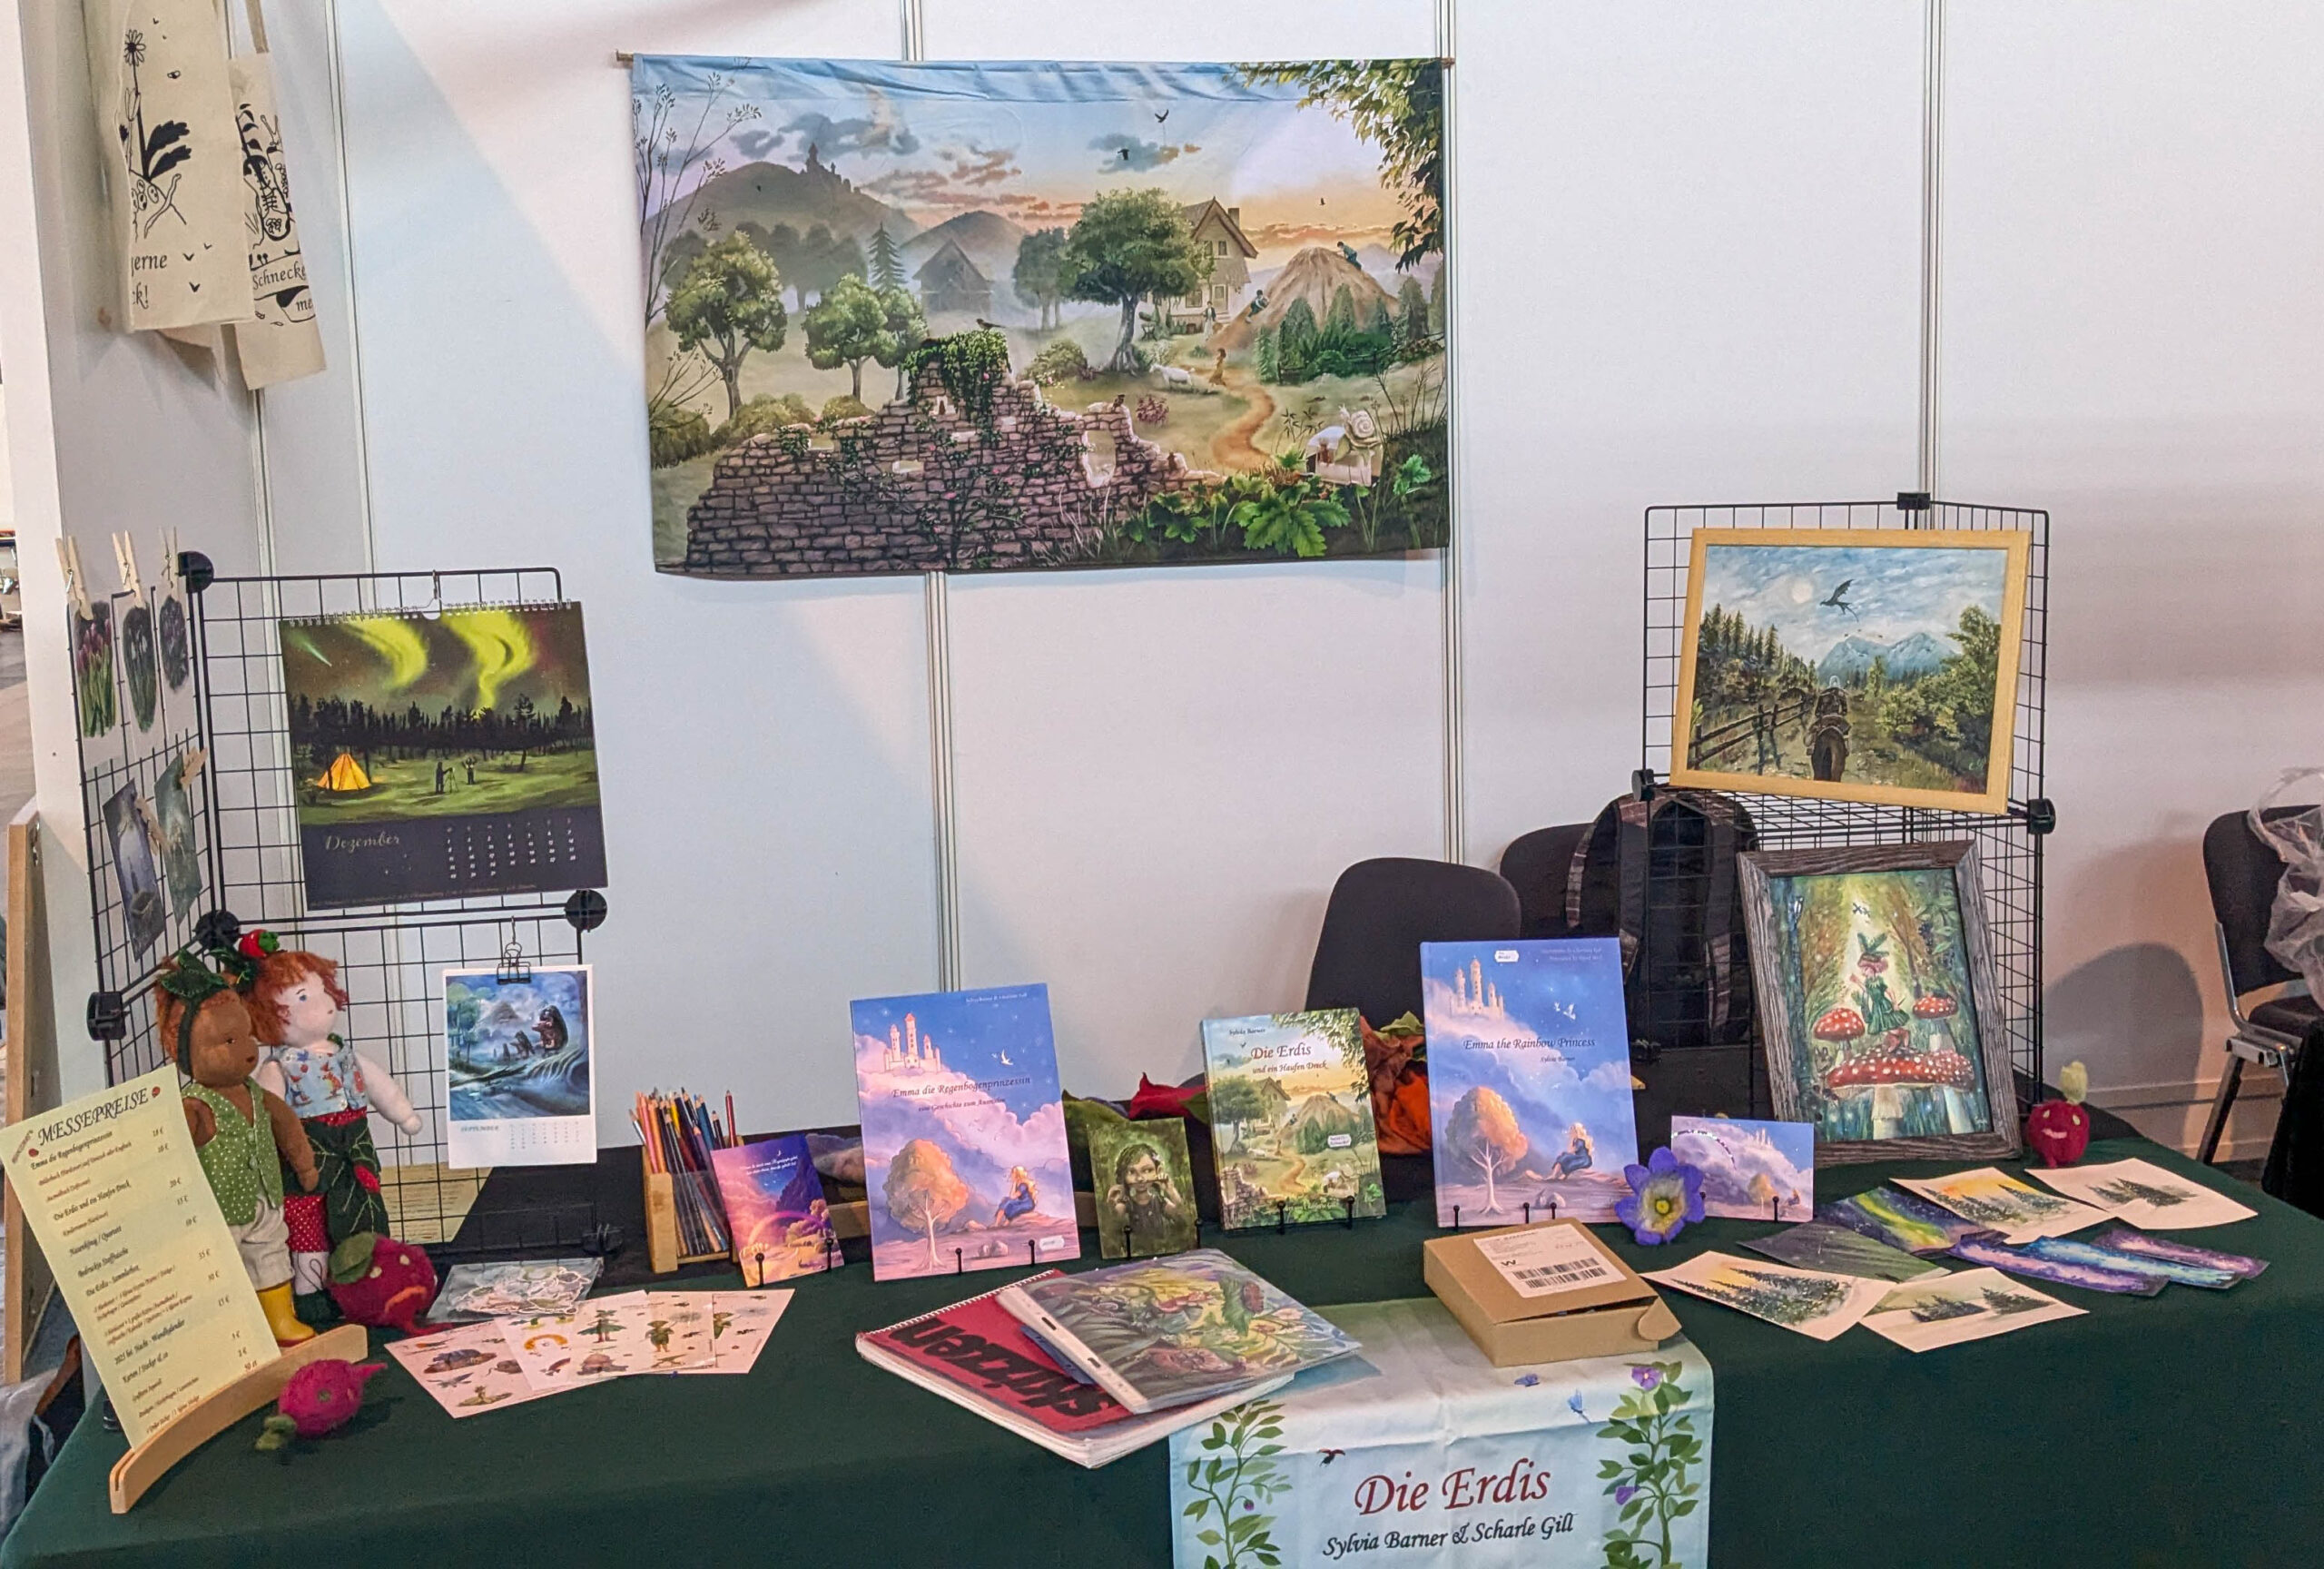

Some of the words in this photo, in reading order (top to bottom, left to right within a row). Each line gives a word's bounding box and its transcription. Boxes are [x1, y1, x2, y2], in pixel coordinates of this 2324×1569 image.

[325, 831, 400, 854] Dezember
[1250, 1045, 1275, 1061] Die
[1276, 1042, 1312, 1059] Erdis
[1462, 1039, 1494, 1051] Emma
[1496, 1037, 1512, 1050] the
[1512, 1036, 1555, 1051] Rainbow
[1555, 1037, 1596, 1049] Princess
[1252, 1064, 1266, 1074] und
[1267, 1064, 1278, 1073] ein
[1278, 1061, 1305, 1076] Haufen
[1305, 1060, 1329, 1071] Dreck
[892, 1089, 921, 1100] Emma
[921, 1084, 936, 1096] die
[937, 1076, 1031, 1095] Regenbogenprinzessin
[37, 1087, 150, 1147] MESSEPREISE
[1354, 1470, 1430, 1516] Die
[1442, 1456, 1551, 1511] Erdis
[1322, 1532, 1380, 1561] Sylvia
[1384, 1530, 1449, 1550] Barner
[1452, 1521, 1471, 1544] &
[1471, 1515, 1536, 1543] Scharle
[1540, 1512, 1579, 1540] Gill
